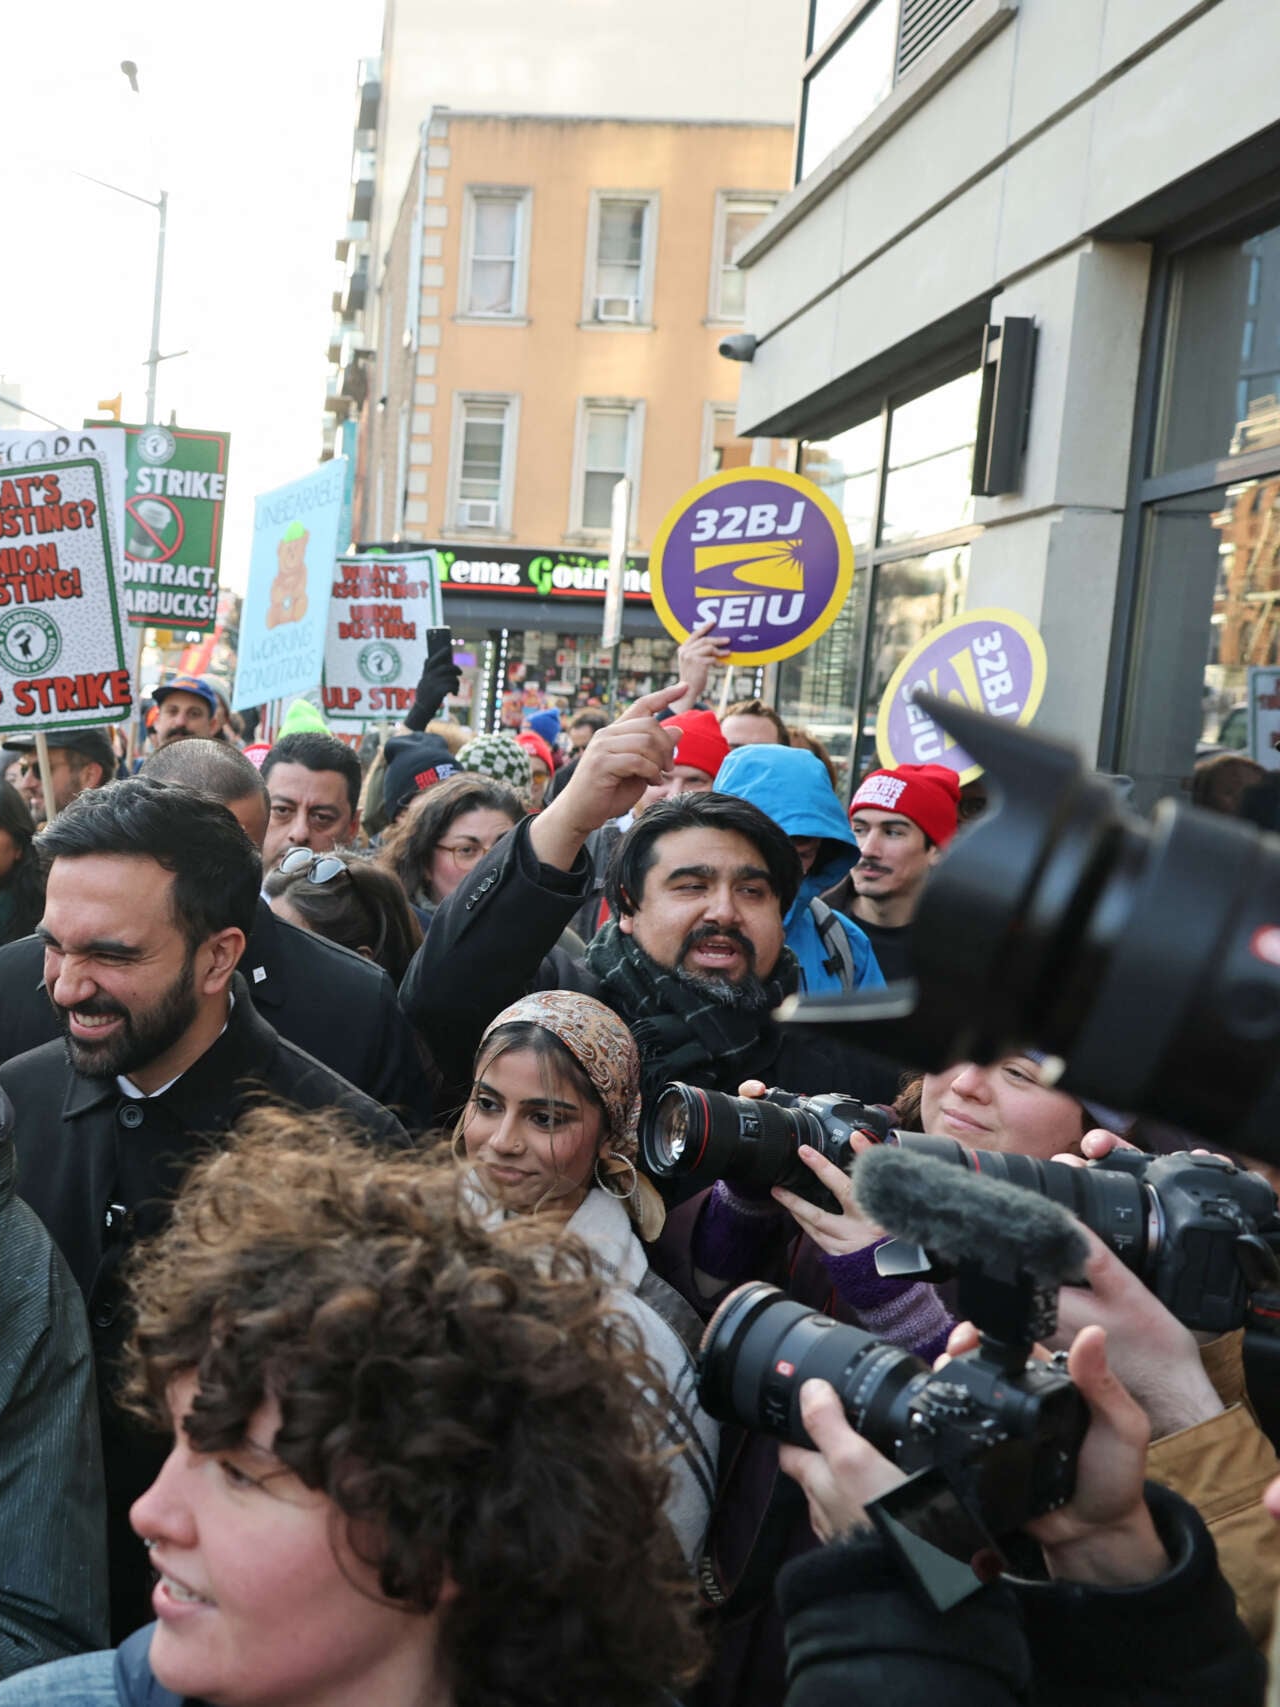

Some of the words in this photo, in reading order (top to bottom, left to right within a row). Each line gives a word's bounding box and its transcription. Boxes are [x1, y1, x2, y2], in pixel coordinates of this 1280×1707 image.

[135, 466, 225, 501] STRIKE
[690, 501, 806, 542] 32BJ
[123, 561, 217, 594] ONTRACT,
[124, 589, 216, 619] ARBUCKS!
[692, 593, 806, 631] SEIU
[972, 630, 1019, 717] 32BJ
[13, 669, 133, 716] STRIKE
[322, 685, 362, 710] ULP
